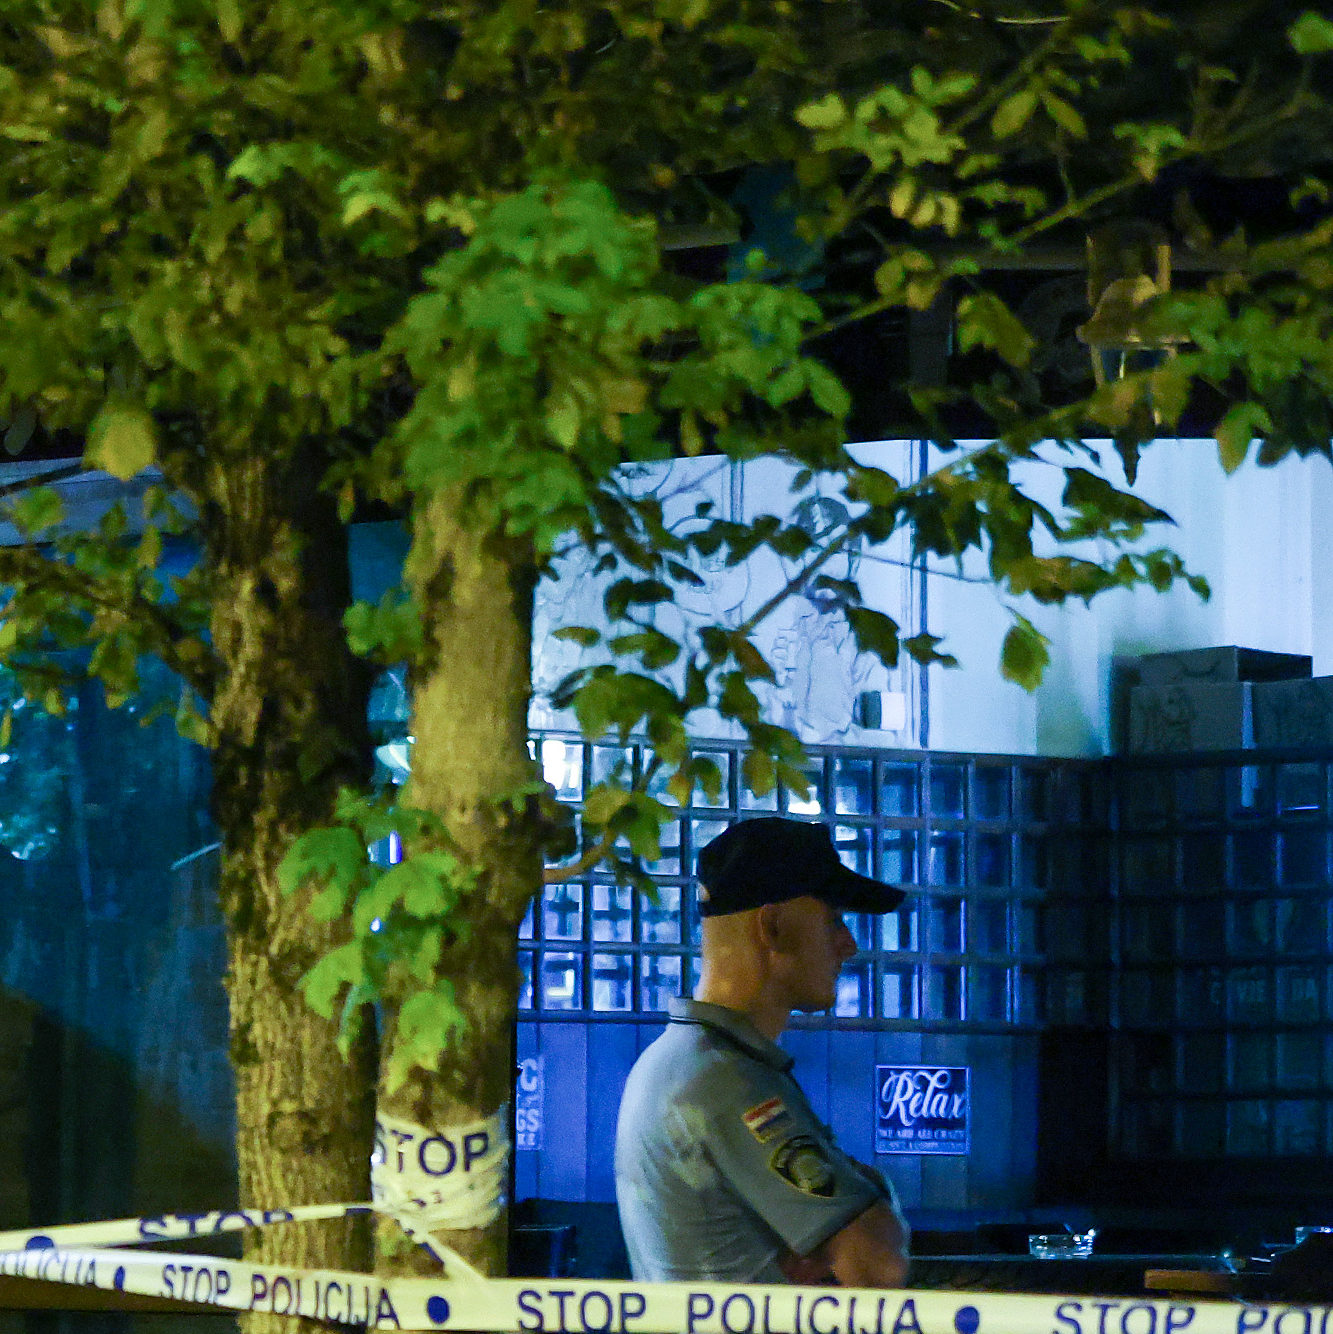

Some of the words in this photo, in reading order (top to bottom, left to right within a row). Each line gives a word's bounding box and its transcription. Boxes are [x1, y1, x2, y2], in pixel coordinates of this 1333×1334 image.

[162, 1263, 231, 1304] STOP
[249, 1273, 401, 1331] POLICIJA
[516, 1289, 647, 1334] STOP
